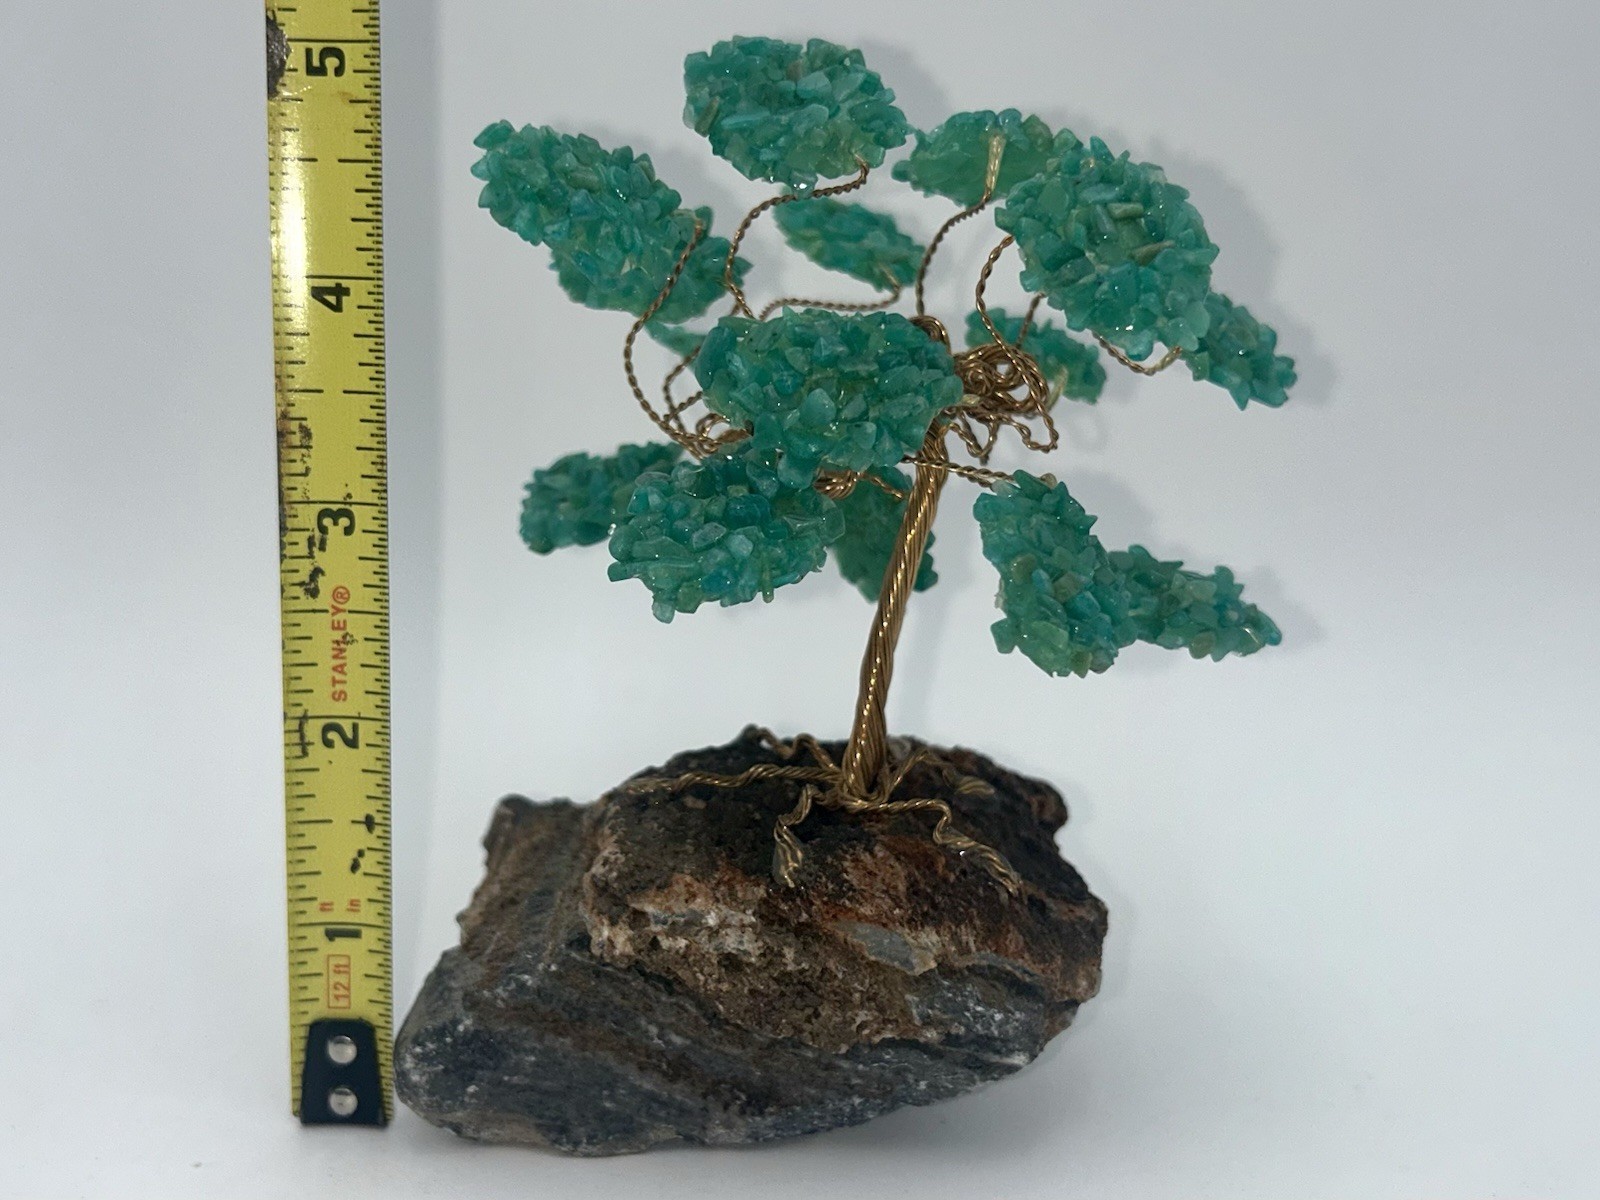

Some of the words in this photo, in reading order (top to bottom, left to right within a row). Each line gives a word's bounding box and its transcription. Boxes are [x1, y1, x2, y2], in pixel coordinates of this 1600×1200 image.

[306, 46, 346, 77] 5
[311, 282, 351, 313] 4
[317, 507, 357, 537] 3
[321, 722, 360, 749] 2
[325, 928, 362, 942] 1
[333, 962, 350, 975] ft
[333, 981, 351, 1003] 12
